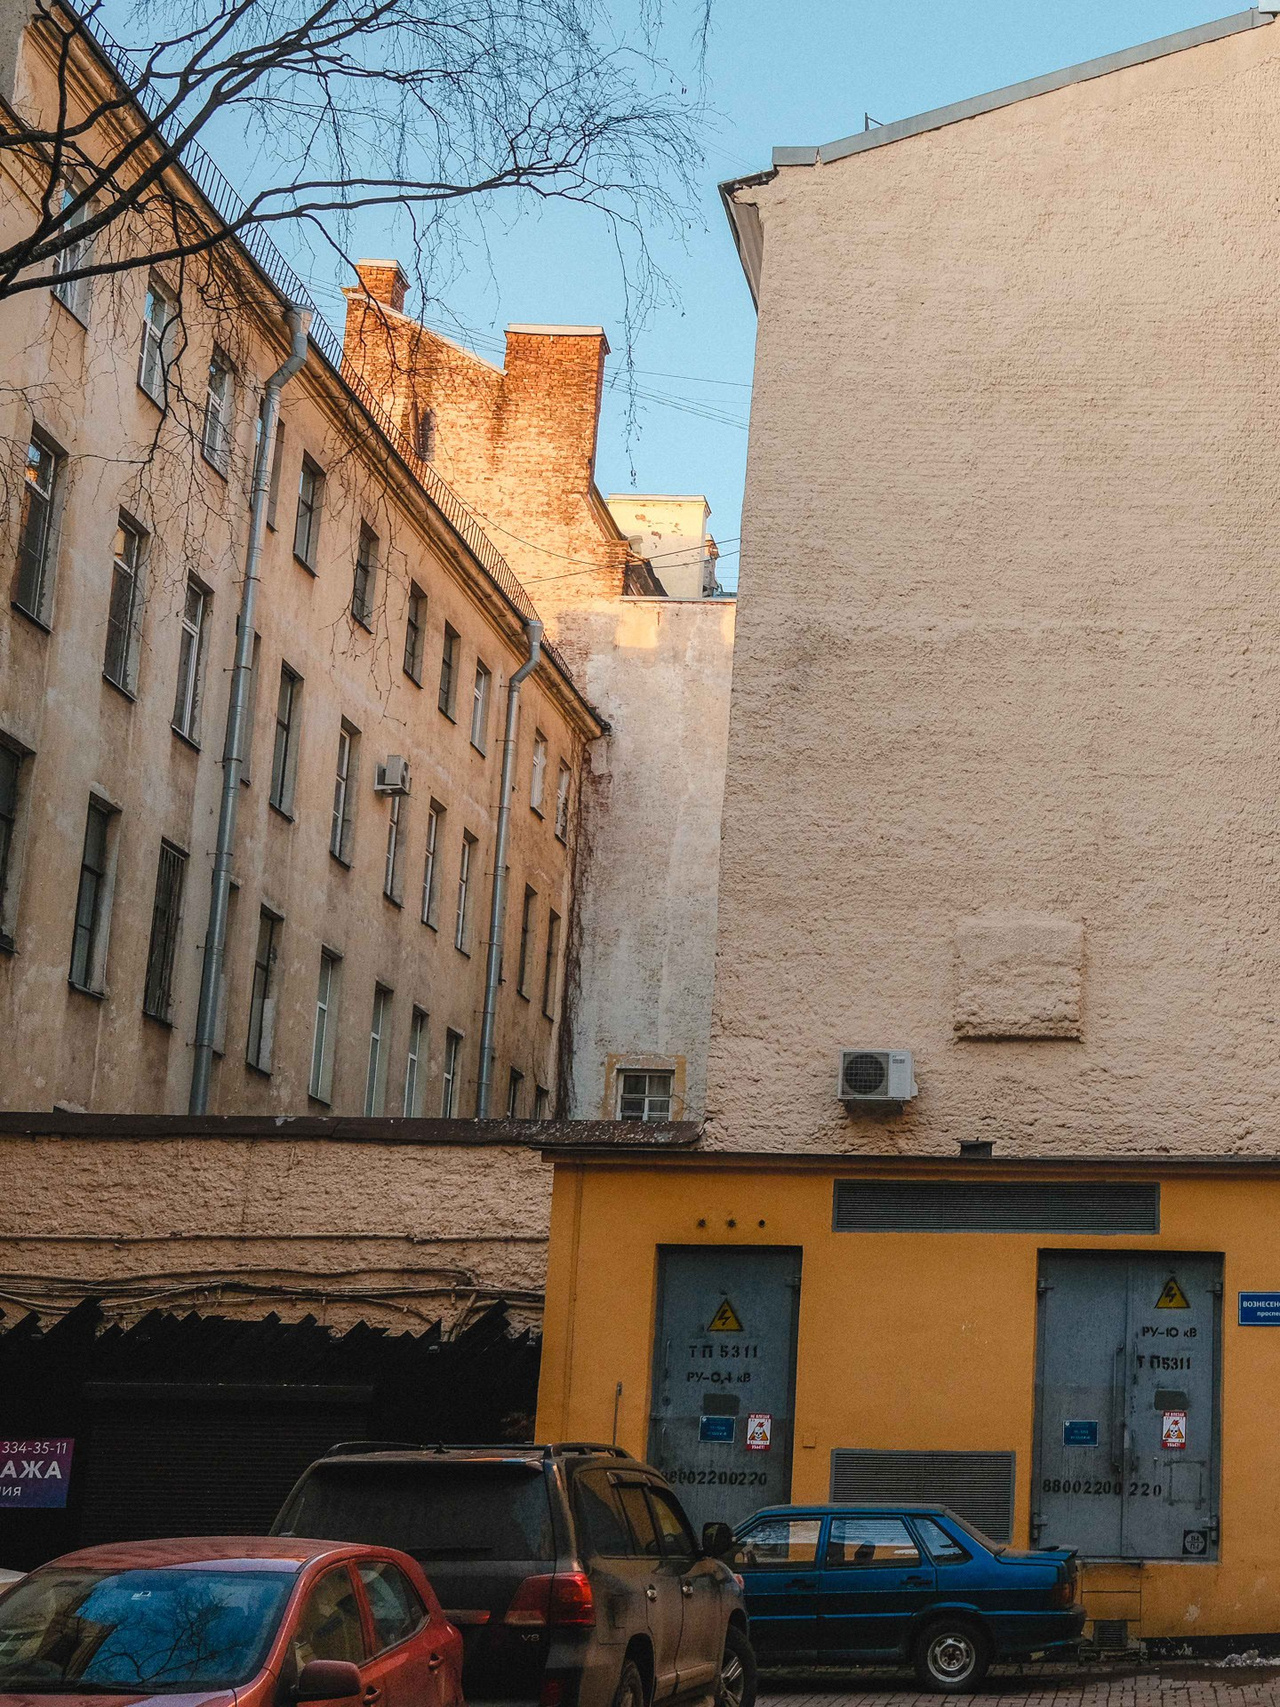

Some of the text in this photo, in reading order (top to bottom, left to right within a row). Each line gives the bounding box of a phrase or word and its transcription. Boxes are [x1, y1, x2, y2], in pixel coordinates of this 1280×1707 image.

[720, 1345, 758, 1359] 5311
[2, 1441, 68, 1455] 334-35-11
[521, 1633, 540, 1642] V8
